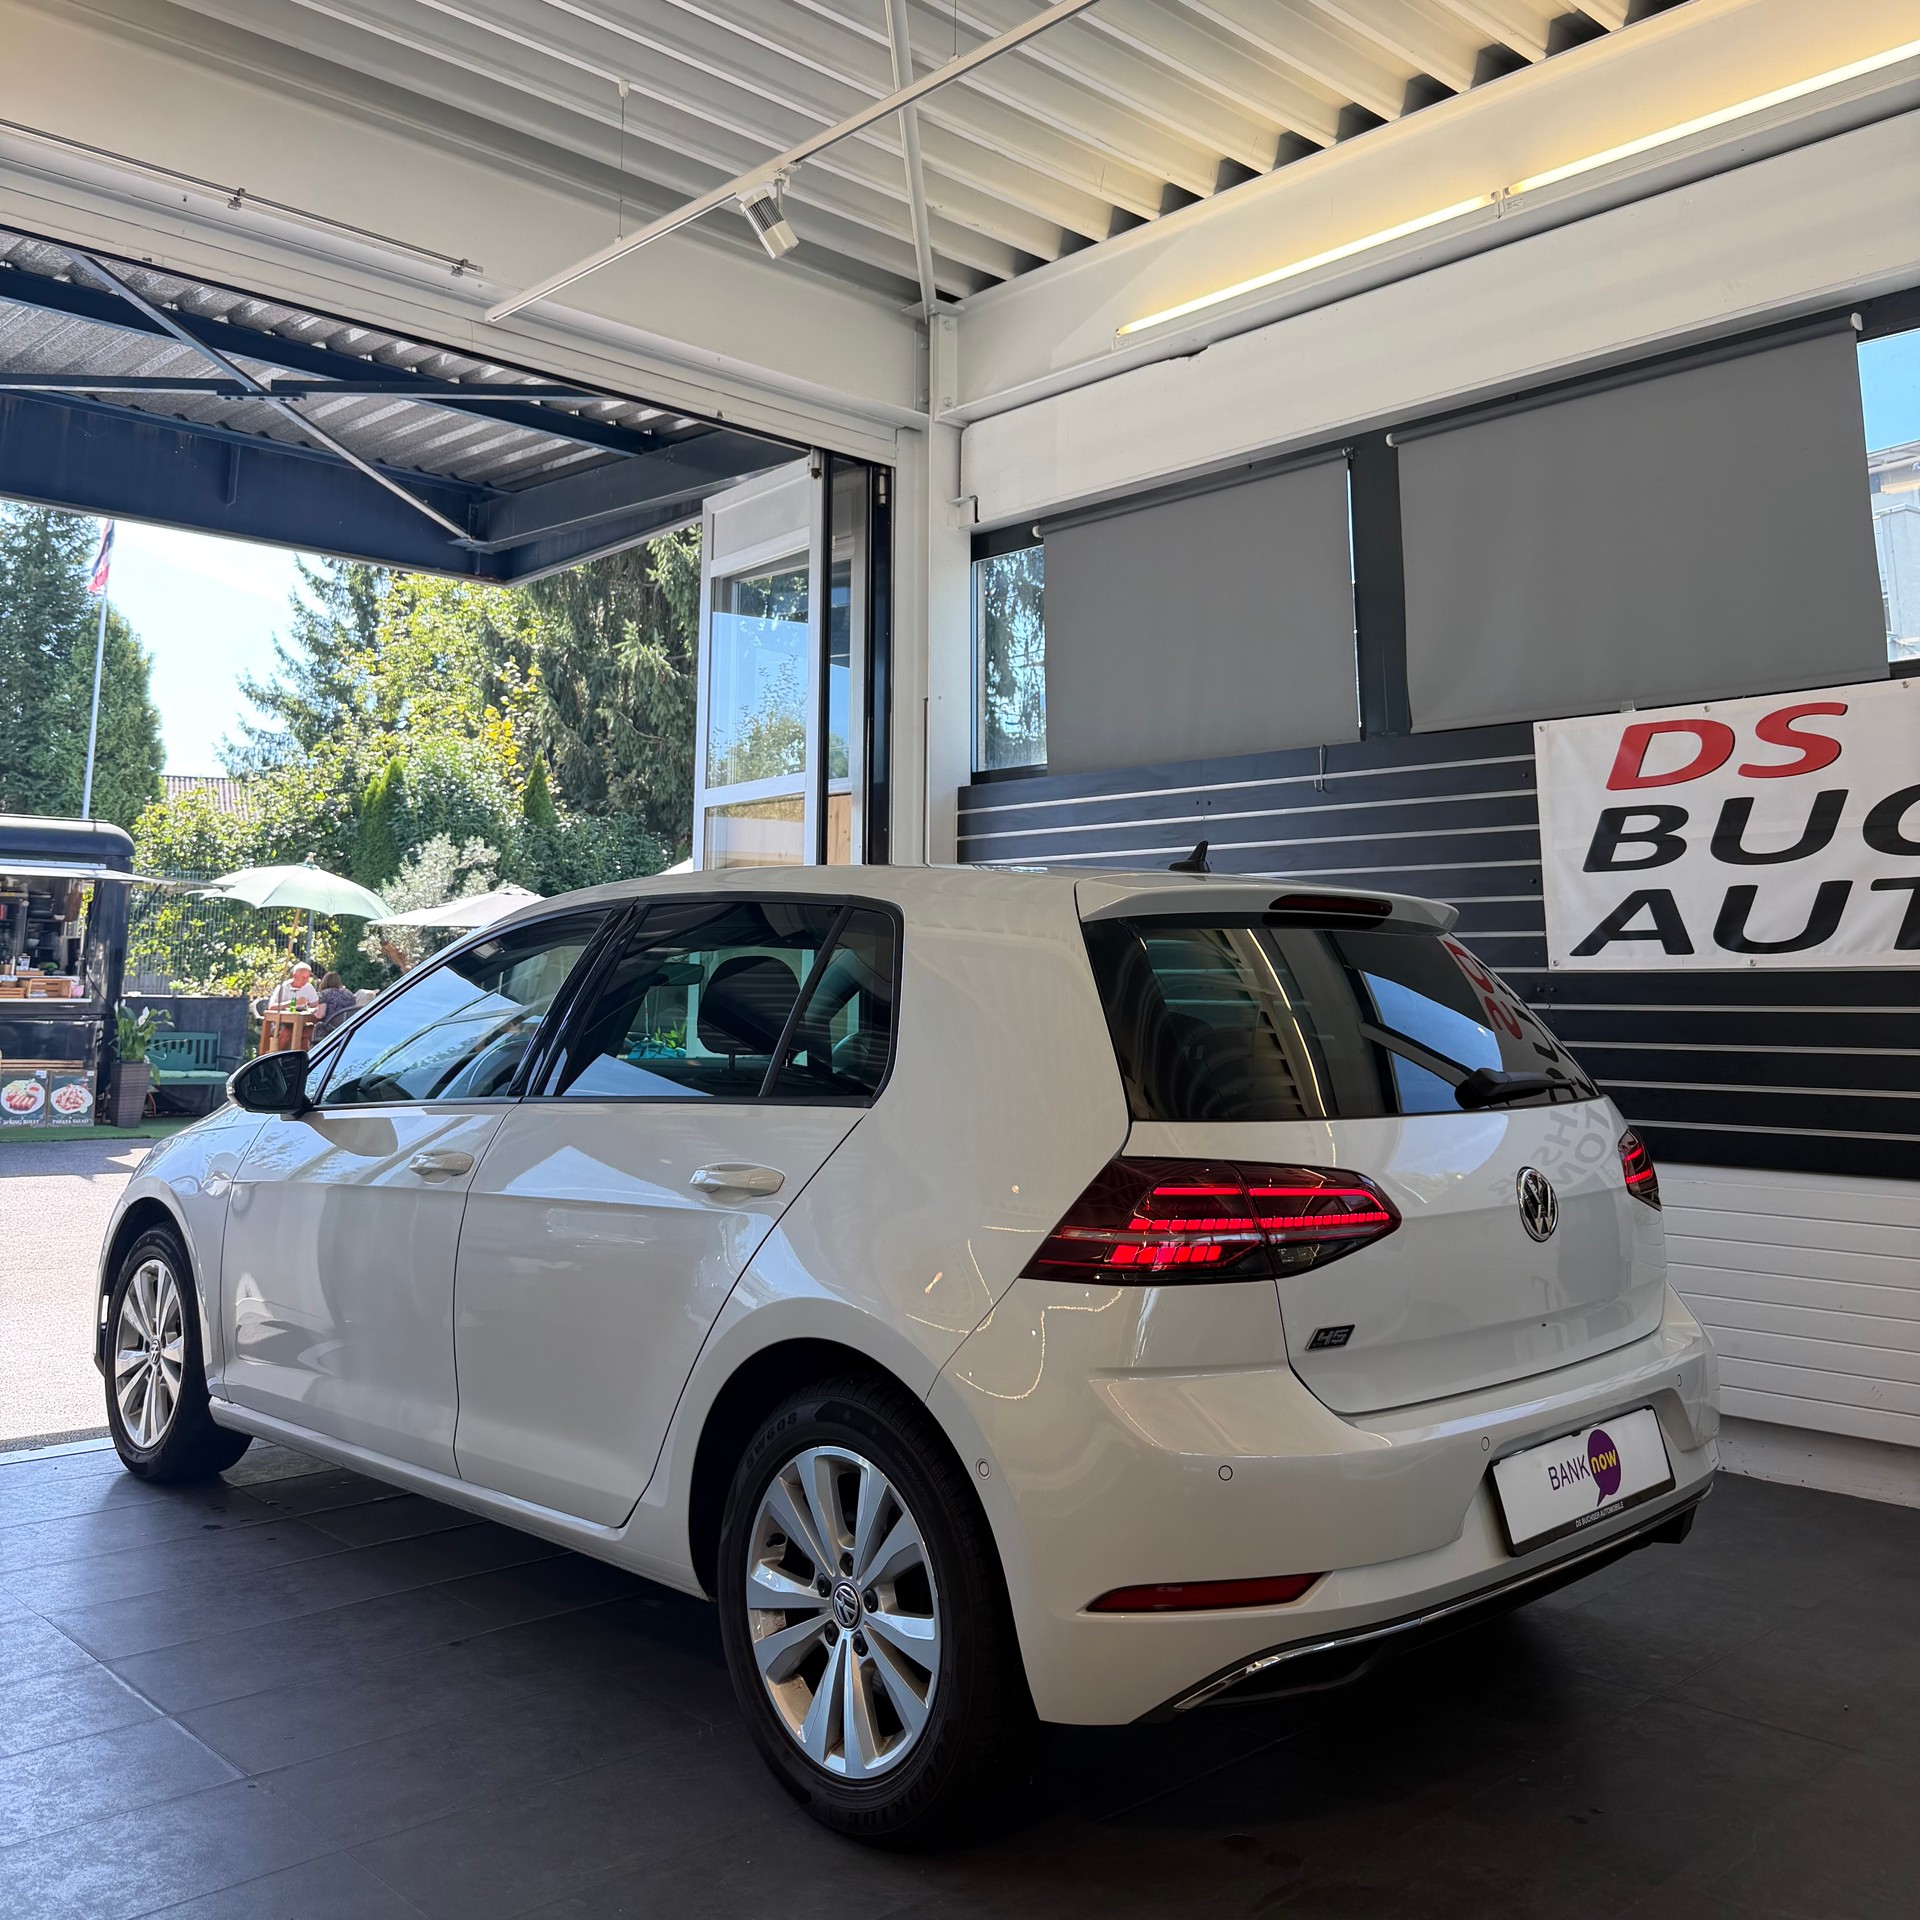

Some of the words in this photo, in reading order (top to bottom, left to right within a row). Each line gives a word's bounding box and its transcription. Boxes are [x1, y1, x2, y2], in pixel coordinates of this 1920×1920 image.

[1606, 702, 1848, 791] DS
[1547, 1455, 1591, 1491] BANK
[1590, 1449, 1617, 1474] now
[1575, 1519, 1582, 1528] DS
[1582, 1511, 1601, 1525] BUCHSER
[1600, 1501, 1625, 1517] AUTOMOBILE
